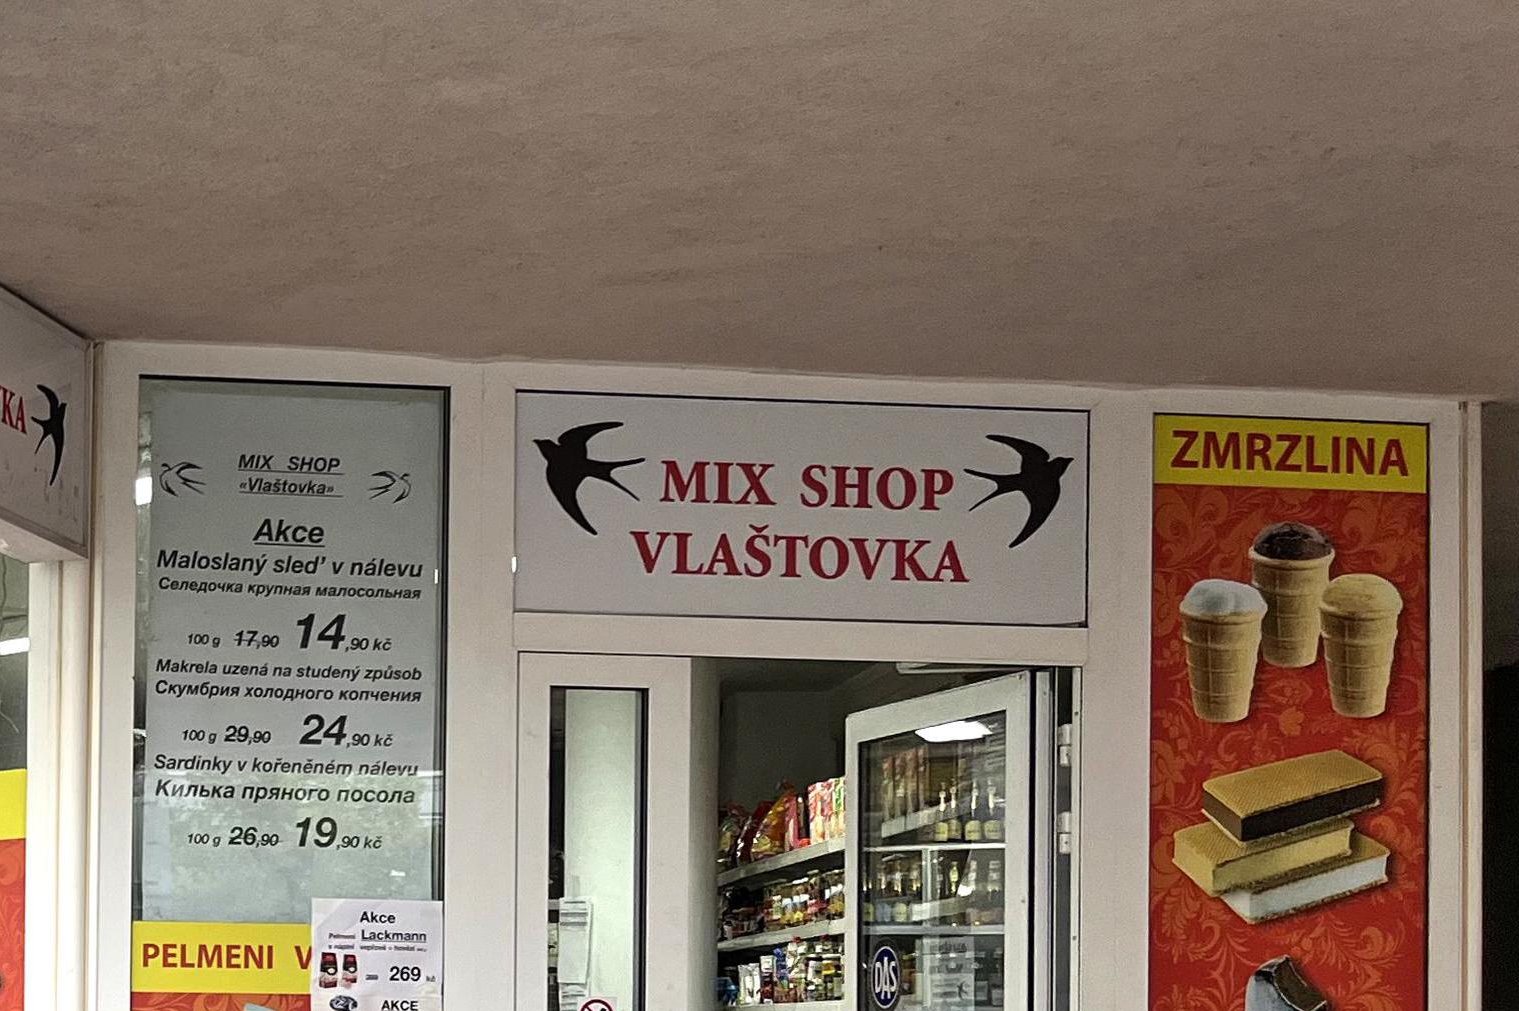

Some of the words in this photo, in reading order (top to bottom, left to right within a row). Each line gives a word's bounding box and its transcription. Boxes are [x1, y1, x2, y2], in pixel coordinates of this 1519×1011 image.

[238, 454, 273, 470] MIX
[287, 456, 340, 472] SHOP
[1170, 430, 1409, 476] ZMRZLINA
[659, 459, 777, 506] MIX
[800, 463, 955, 511] SHOP
[253, 519, 324, 543] Akce
[157, 550, 267, 575] Maloslaný
[332, 561, 344, 574] v
[349, 557, 423, 577] nálevu
[630, 524, 970, 583] VLAŠTOVKA
[158, 577, 243, 594] Селедочка
[247, 583, 310, 598] крупная
[315, 586, 421, 600] малосольная
[187, 633, 209, 645] 100
[212, 637, 221, 648] g
[372, 638, 392, 651] kč
[156, 659, 217, 675] Makrela
[222, 662, 268, 677] uzená
[273, 667, 292, 677] na
[296, 665, 360, 681] studený
[364, 665, 422, 682] způsob
[155, 680, 240, 698] Скумбрия
[244, 686, 333, 701] холодного
[339, 690, 421, 702] копчения
[182, 729, 206, 742] 100
[208, 732, 217, 744] g
[374, 733, 393, 747] kč
[154, 754, 232, 773] Sardinky
[237, 760, 247, 771] v
[252, 757, 352, 777] kořeněném
[359, 761, 418, 777] nálevu
[155, 780, 234, 799] Килька
[242, 785, 330, 803] пряного
[337, 789, 415, 803] посола
[187, 833, 210, 845] 100
[213, 837, 221, 848] g
[364, 836, 382, 850] kč
[360, 911, 396, 923] Akce
[361, 929, 427, 942] Lackmann
[142, 943, 274, 970] PELMENI
[389, 966, 421, 982] 269
[381, 1000, 419, 1011] AKCE
